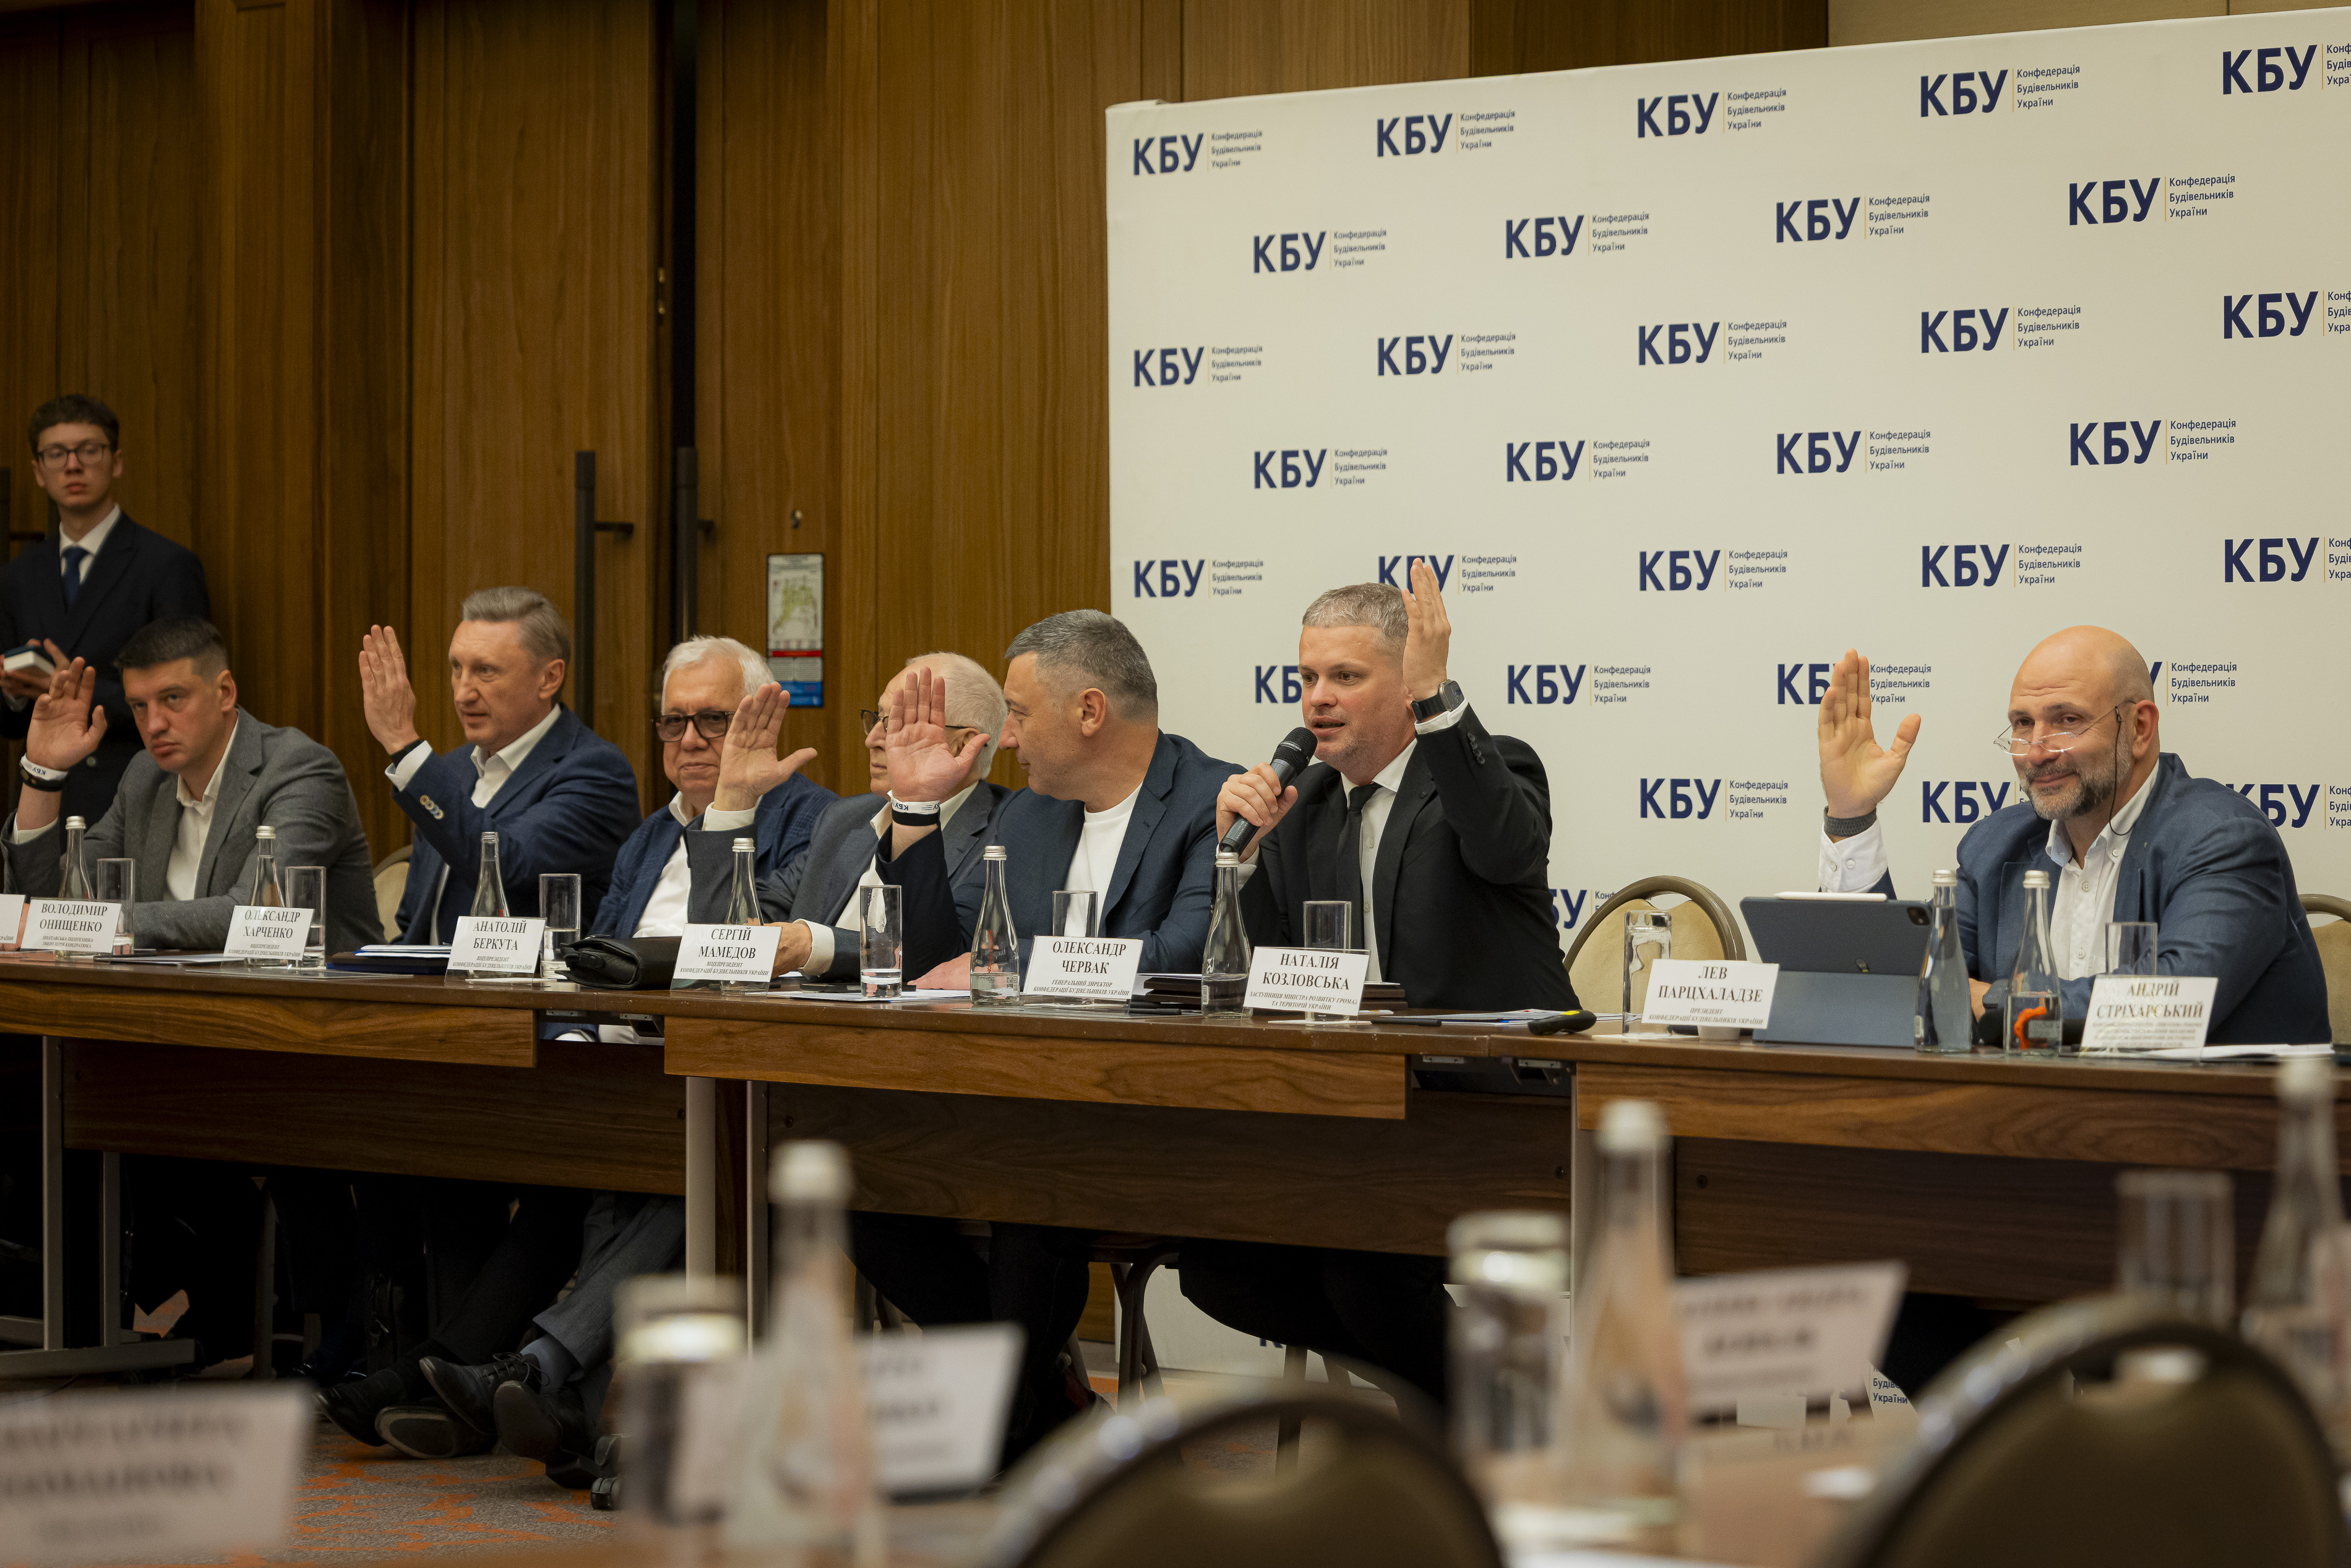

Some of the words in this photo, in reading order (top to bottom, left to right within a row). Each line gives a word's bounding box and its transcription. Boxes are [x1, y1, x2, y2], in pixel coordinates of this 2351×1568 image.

[2016, 64, 2081, 79] Конфедерація
[2223, 45, 2318, 95] КБУ
[2327, 75, 2351, 85] Укра
[1727, 87, 1787, 101] Конфедерація
[1920, 69, 2008, 118] КБУ
[2017, 79, 2079, 96] Будівельників
[1727, 102, 1786, 118] Будівельників
[2017, 97, 2053, 110] України
[1460, 111, 1516, 122] Конфедерація
[1638, 92, 1719, 139] КБУ
[1460, 124, 1515, 137] Будівельників
[1727, 119, 1762, 132] України
[1211, 131, 1263, 142] Конфедерація
[1377, 113, 1453, 158] КБУ
[1211, 145, 1261, 156] Будівельників
[1460, 139, 1492, 151] України
[1133, 133, 1204, 176] КБУ
[1211, 159, 1241, 169] України
[2169, 173, 2235, 189] Конфедерація
[1868, 193, 1930, 207] Конфедерація
[2069, 178, 2160, 226] КБУ
[2169, 189, 2234, 205] Будівельників
[1592, 212, 1649, 225] Конфедерація
[1868, 208, 1929, 223] Будівельників
[2169, 206, 2207, 220] України
[1776, 197, 1860, 243] КБУ
[1333, 229, 1387, 241] Конфедерація
[1506, 215, 1584, 259] КБУ
[1592, 226, 1648, 239] Будівельників
[1868, 225, 1904, 238] України
[1253, 231, 1326, 274] КБУ
[1333, 243, 1386, 255] Будівельників
[1592, 242, 1625, 254] України
[1334, 257, 1365, 268] України
[2018, 304, 2081, 319] Конфедерація
[2224, 291, 2319, 339] КБУ
[1727, 319, 1787, 332] Конфедерація
[1921, 307, 2009, 353] КБУ
[2018, 320, 2080, 335] Будівельників
[2327, 322, 2351, 334] Укра
[1461, 333, 1516, 344] Конфедерація
[1638, 322, 1720, 366] КБУ
[1728, 334, 1786, 348] Будівельників
[2018, 336, 2055, 349] України
[1211, 346, 1263, 356] Конфедерація
[1378, 334, 1453, 376] КБУ
[1461, 347, 1515, 359] Будівельників
[1728, 349, 1762, 362] України
[1133, 346, 1205, 387] КБУ
[1211, 359, 1261, 369] Будівельників
[1461, 361, 1493, 372] України
[1211, 374, 1241, 383] України
[2170, 418, 2237, 432] Конфедерація
[1869, 429, 1931, 442] Конфедерація
[2170, 433, 2235, 448] Будівельників
[1592, 439, 1650, 451] Конфедерація
[2070, 420, 2162, 466] КБУ
[1334, 448, 1388, 459] Конфедерація
[1777, 431, 1862, 474] КБУ
[1869, 443, 1930, 457] Будівельників
[1506, 440, 1585, 482] КБУ
[1593, 453, 1649, 466] Будівельників
[2170, 451, 2209, 463] України
[1254, 448, 1327, 489] КБУ
[1335, 462, 1386, 473] Будівельників
[1869, 460, 1905, 472] України
[1593, 468, 1626, 479] України
[1335, 476, 1365, 487] України
[1729, 549, 1788, 561] Конфедерація
[2018, 543, 2082, 556] Конфедерація
[1212, 560, 1264, 570] Конфедерація
[1461, 554, 1517, 565] Конфедерація
[1922, 544, 2010, 588] КБУ
[2018, 558, 2081, 572] Будівельників
[2225, 538, 2319, 583] КБУ
[1461, 568, 1516, 580] Будівельників
[1640, 549, 1721, 591] КБУ
[1729, 563, 1787, 576] Будівельників
[2329, 570, 2351, 581] Укра
[1134, 559, 1205, 598] КБУ
[1212, 573, 1263, 583] Будівельників
[1729, 578, 1763, 590] України
[2018, 574, 2055, 586] України
[1212, 586, 1242, 596] України
[1462, 583, 1494, 594] України
[1594, 665, 1651, 676] Конфедерація
[1870, 664, 1931, 675] Конфедерація
[2171, 661, 2237, 674] Конфедерація
[1255, 665, 1302, 704] КБ
[1507, 664, 1586, 705] КБУ
[1594, 679, 1650, 690] Будівельників
[1777, 664, 1835, 705] КБ
[1870, 679, 1930, 690] Будівельників
[2171, 677, 2236, 690] Будівельників
[1594, 693, 1627, 705] України
[1870, 694, 1906, 705] України
[2171, 693, 2209, 705] України
[1729, 780, 1789, 792] Конфедерація
[1640, 778, 1722, 820] КБУ
[1729, 794, 1787, 806] Будівельників
[1729, 808, 1764, 820] України
[2329, 816, 2351, 827] Укра
[41, 903, 108, 916] ВОЛОДИМИР
[245, 909, 301, 922] ОЛЕКСАНДР
[40, 919, 102, 932] ОНИЩЕНКО
[243, 926, 293, 938] ХАРЧЕНКО
[473, 920, 527, 933] АНАТОЛІЙ
[711, 927, 751, 940] СЕРГІЙ
[473, 938, 518, 950] БЕРКУТА
[1053, 941, 1126, 958] ОЛЕКСАНДР
[698, 946, 755, 960] МАМЕДОВ
[1062, 960, 1109, 974] ЧЕРВАК
[1281, 954, 1339, 969] НАТАЛІЯ
[1698, 966, 1727, 979] ЛЕВ
[1263, 972, 1349, 990] КОЗЛОВСЬКА
[2127, 979, 2180, 996] АНДРІЙ
[1658, 985, 1763, 1003] ПАРЦХАЛАДЗЕ
[2097, 1001, 2203, 1018] СТРІХАРСЬКИЙ
